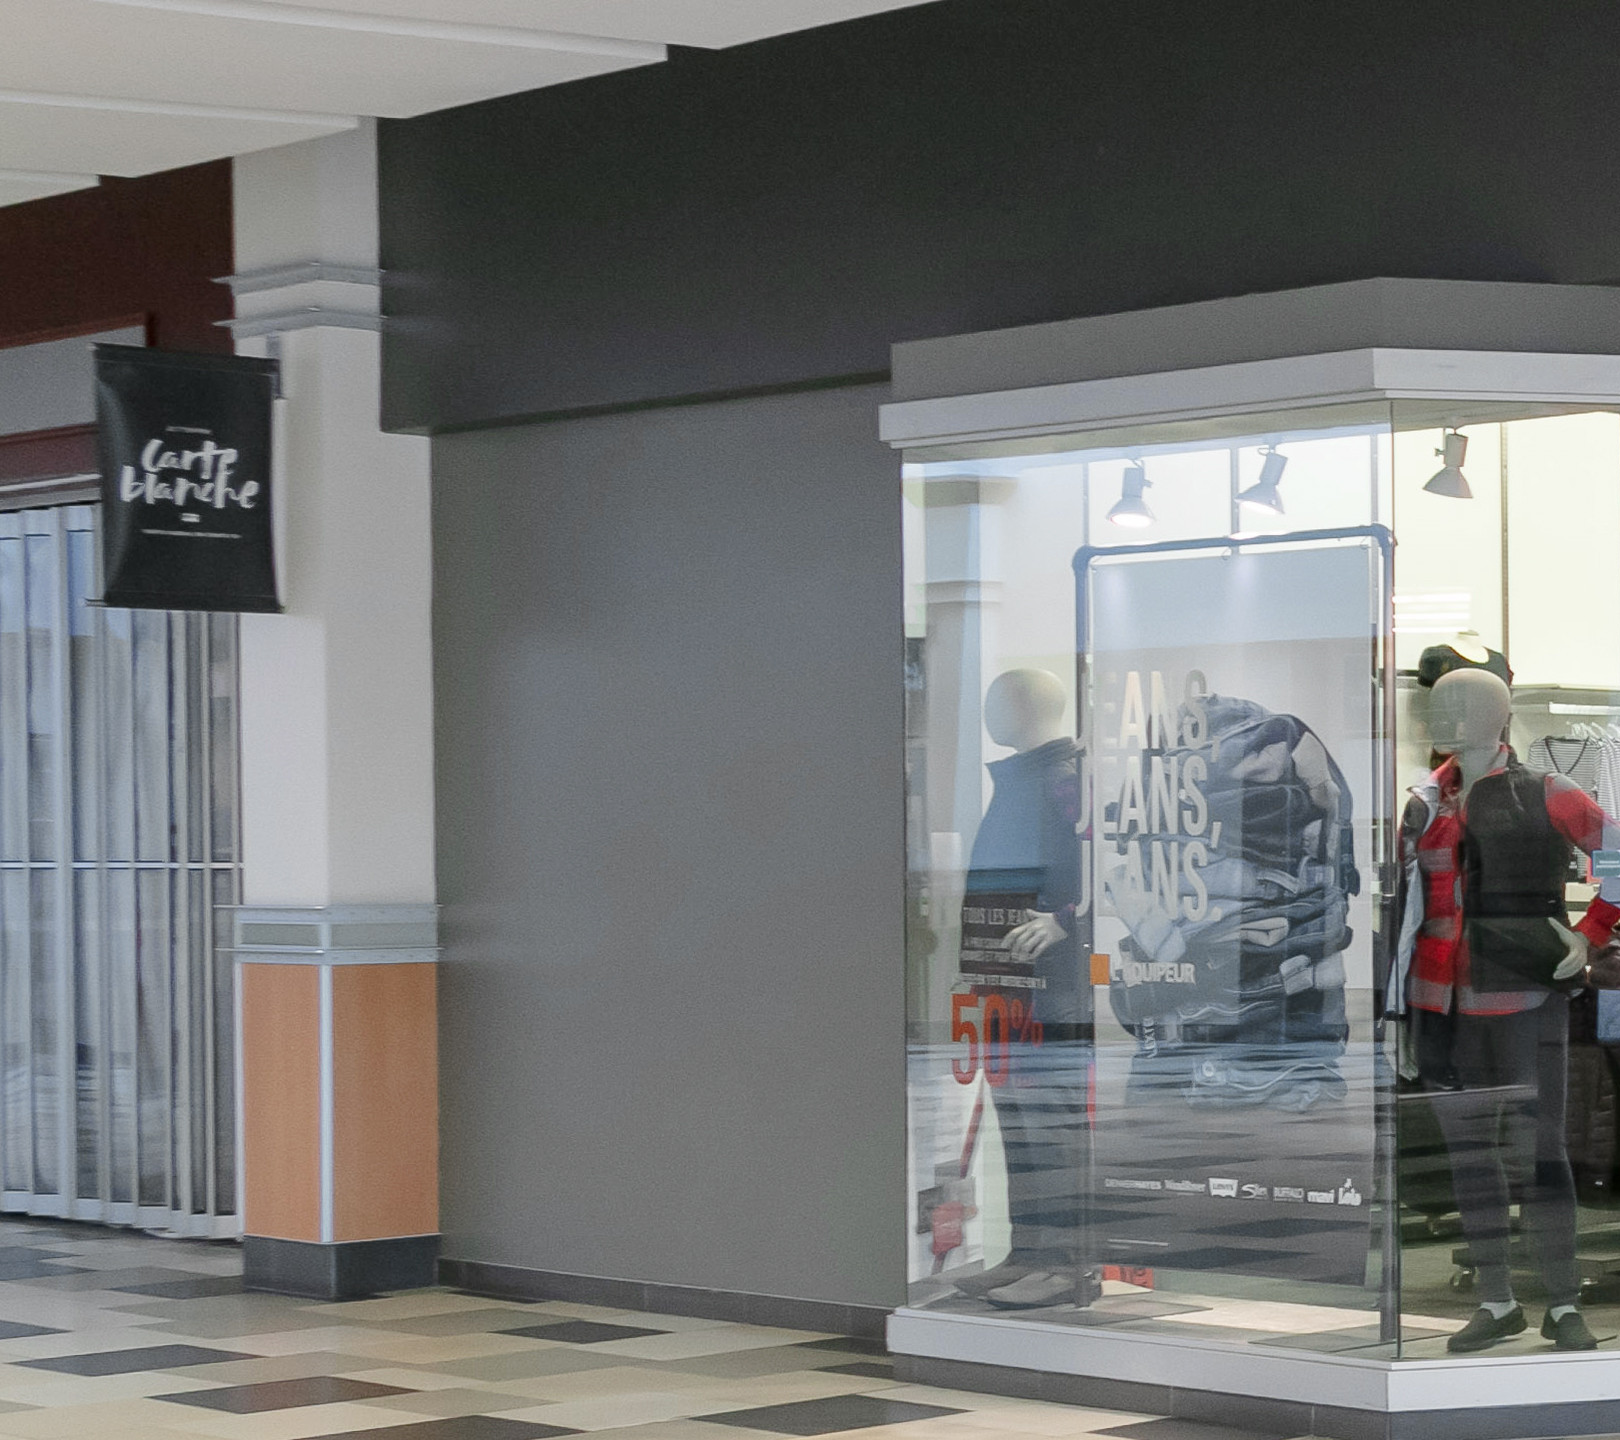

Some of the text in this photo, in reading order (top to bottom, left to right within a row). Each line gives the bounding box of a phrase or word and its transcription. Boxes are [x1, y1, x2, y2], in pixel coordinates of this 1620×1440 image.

[141, 438, 238, 479] Carte
[120, 465, 260, 509] blanche
[952, 994, 1044, 1087] 50%
